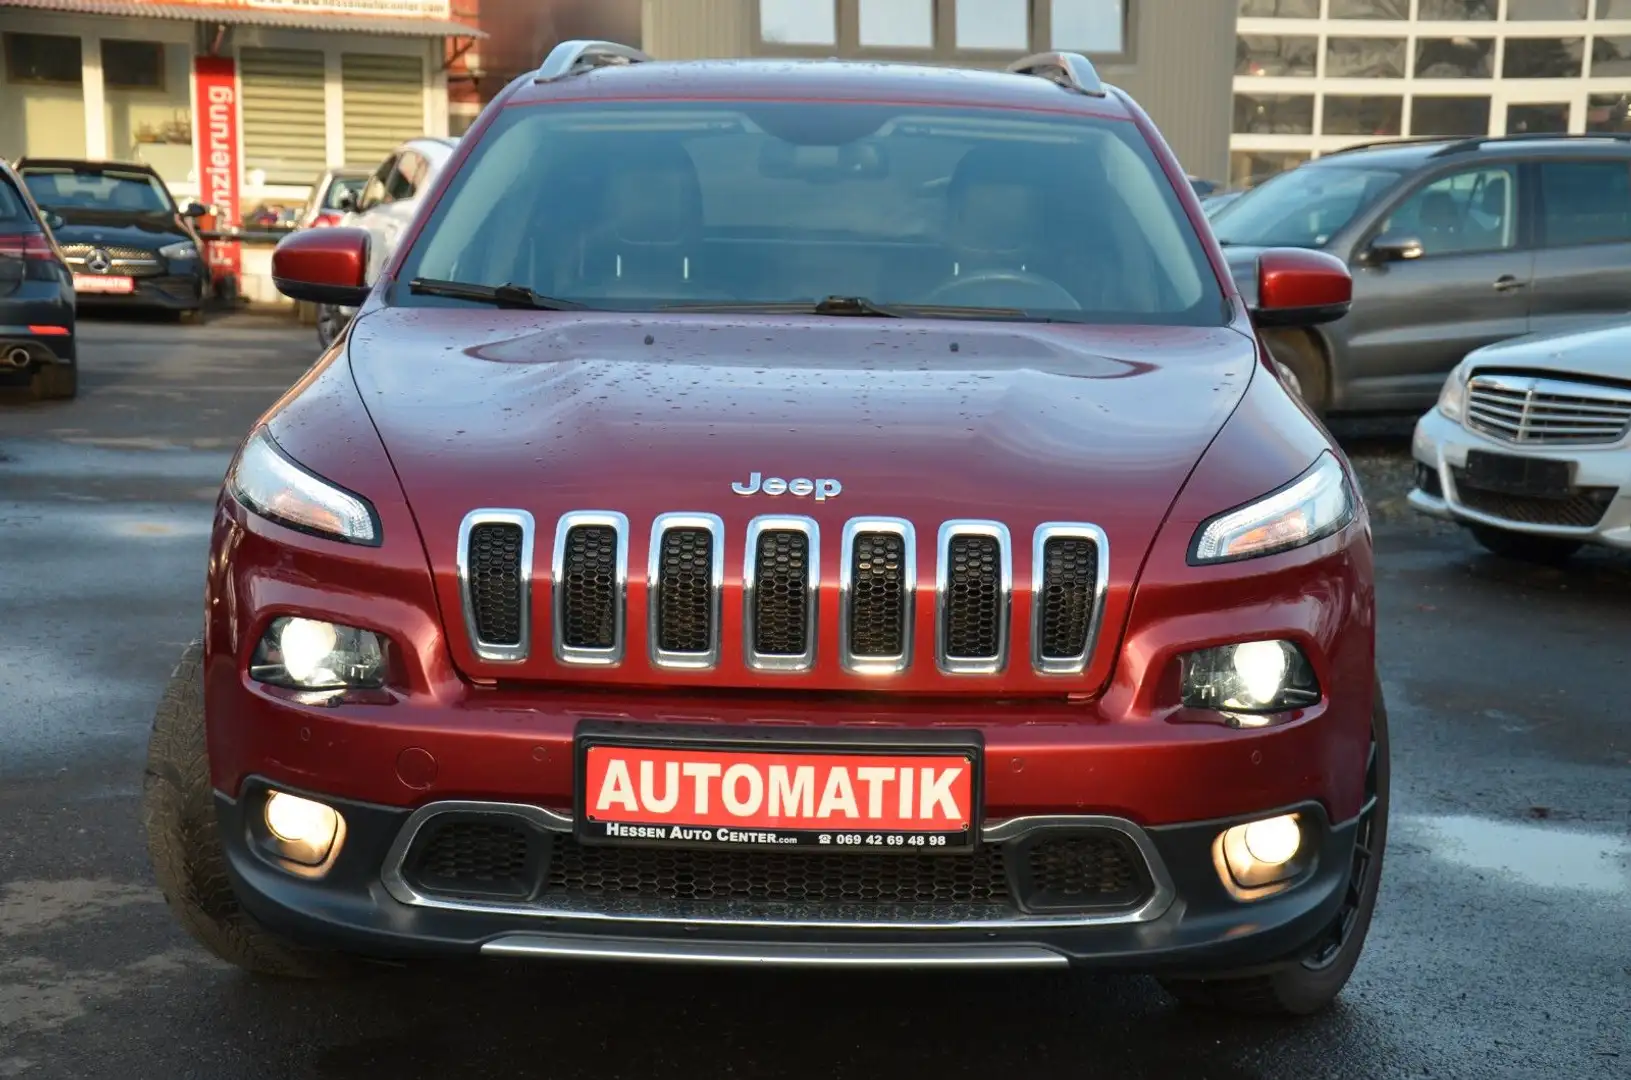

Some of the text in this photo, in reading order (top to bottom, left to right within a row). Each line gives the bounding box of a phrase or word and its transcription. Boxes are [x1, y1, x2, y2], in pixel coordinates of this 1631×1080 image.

[207, 85, 233, 266] Finzierung
[731, 471, 842, 501] Jeep
[596, 759, 963, 820] AUTOMATIK
[669, 826, 712, 841] AUTO
[836, 834, 946, 846] 069 42 69 48 98
